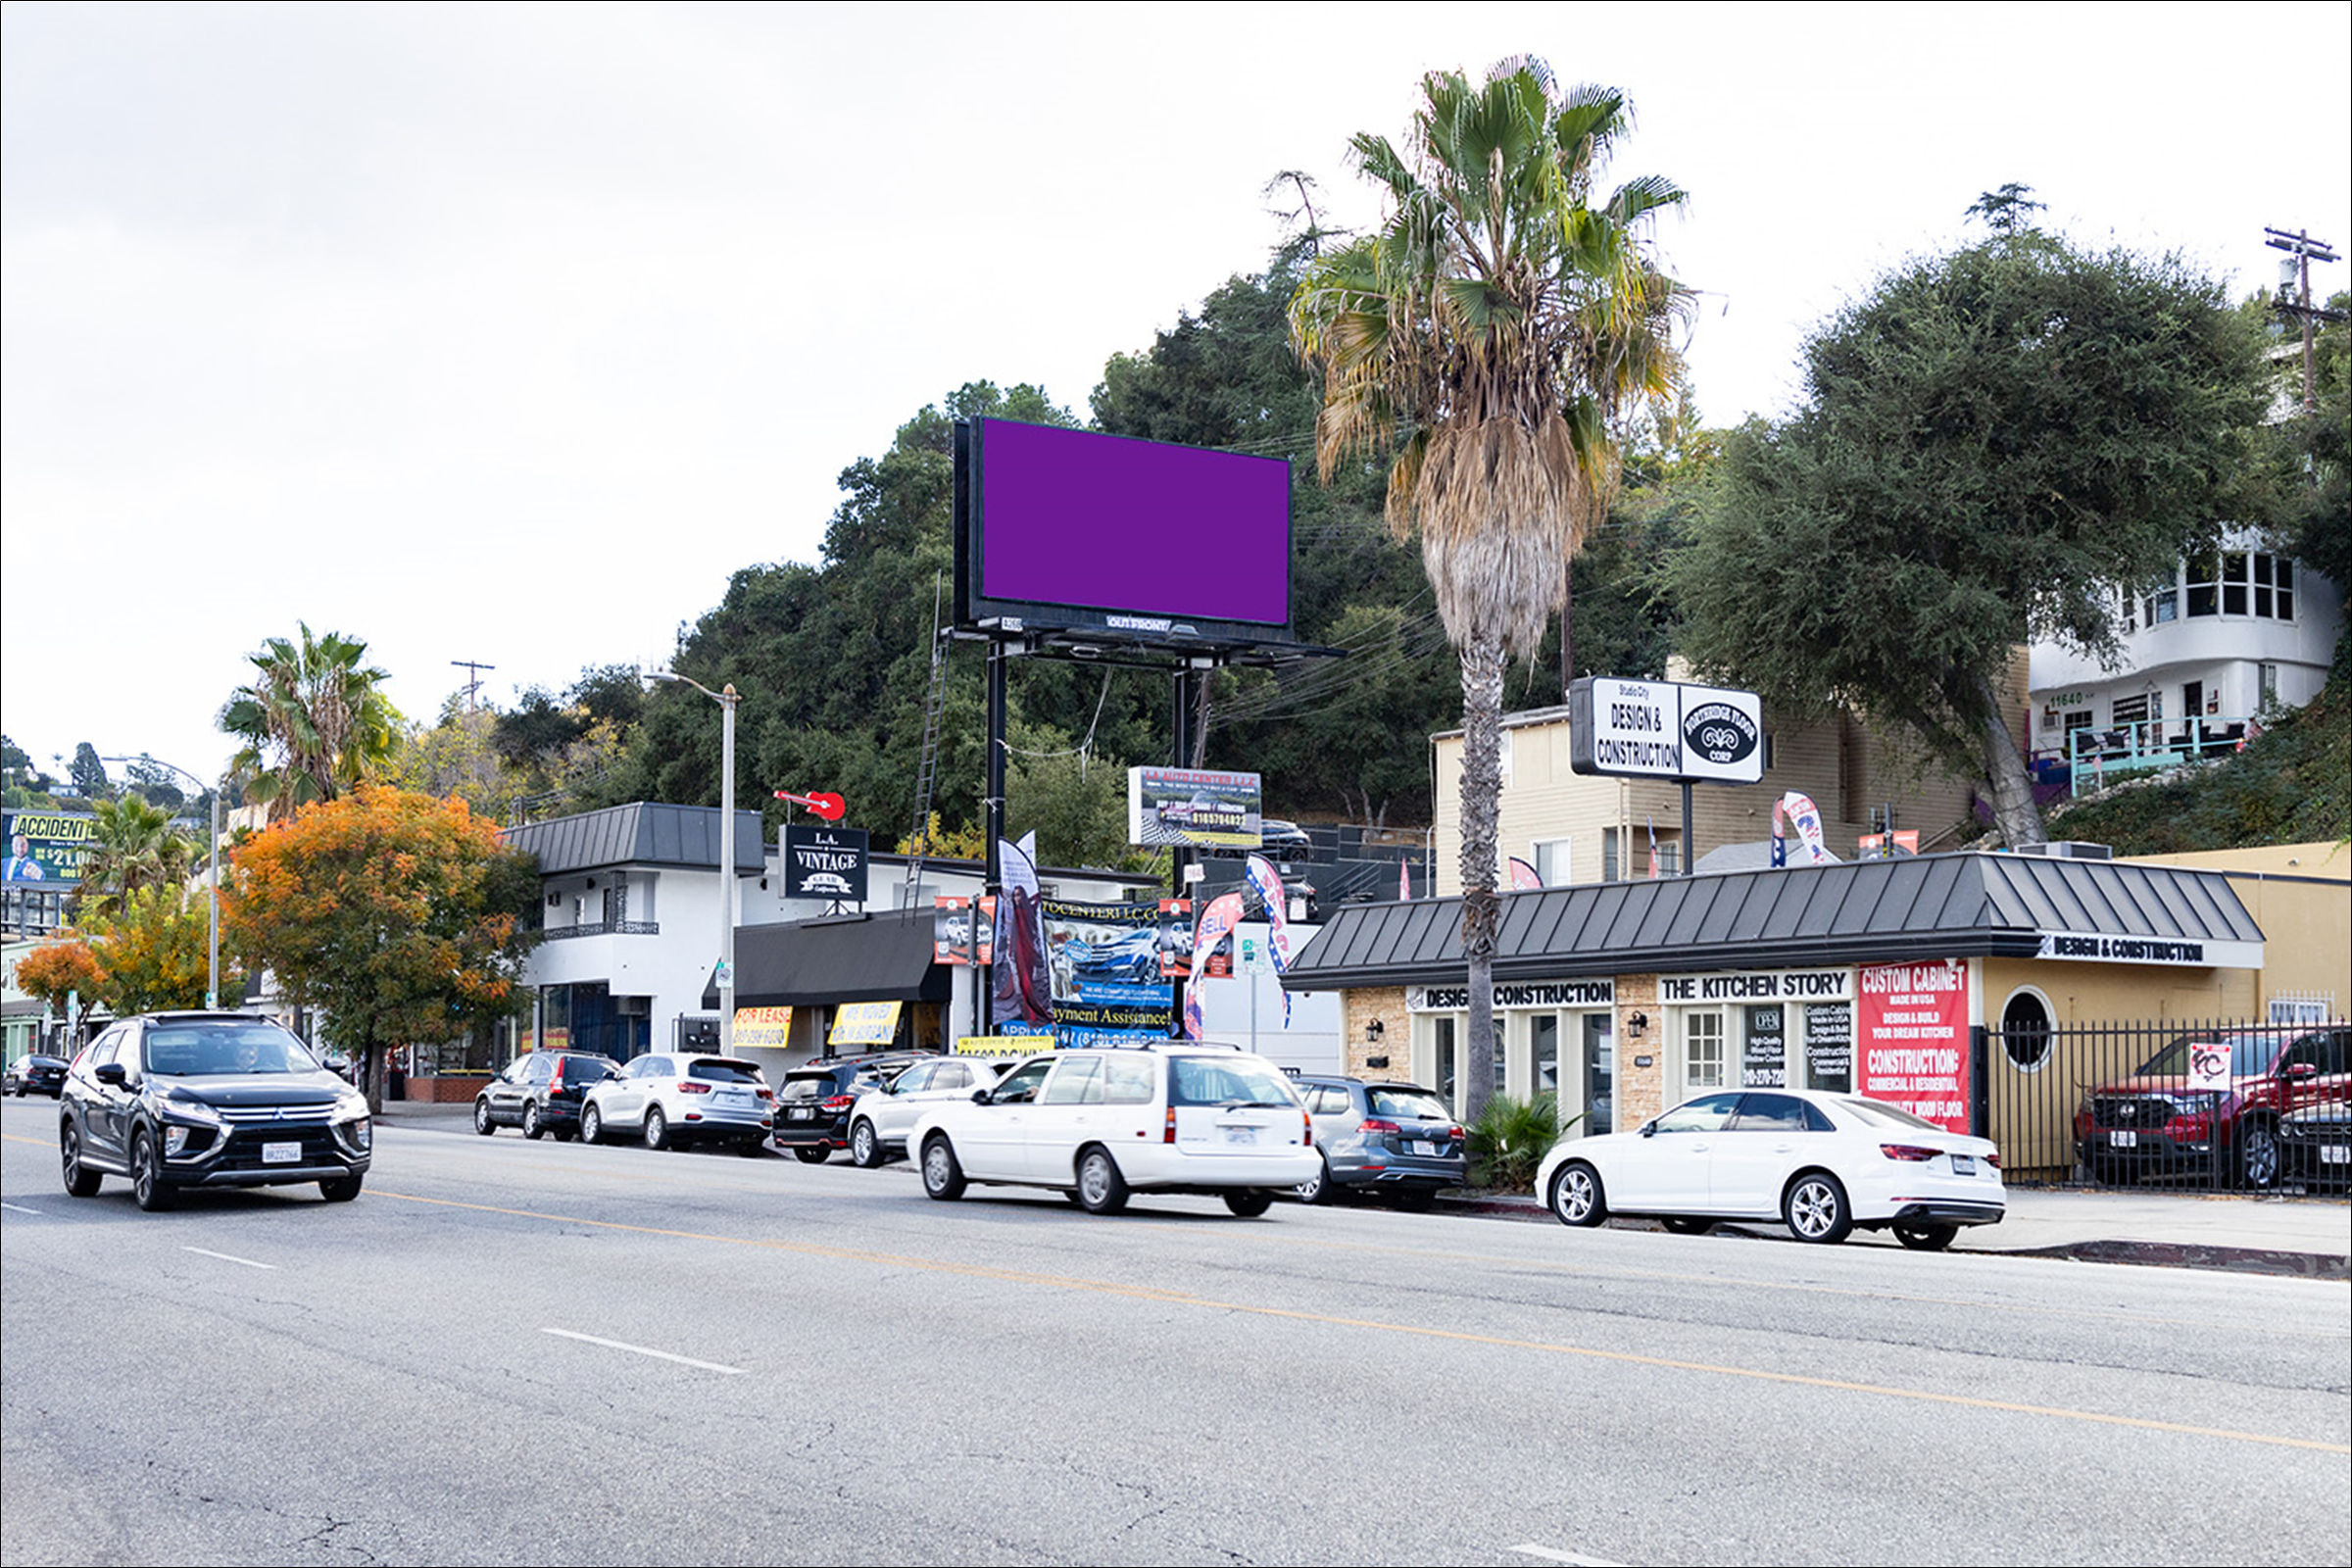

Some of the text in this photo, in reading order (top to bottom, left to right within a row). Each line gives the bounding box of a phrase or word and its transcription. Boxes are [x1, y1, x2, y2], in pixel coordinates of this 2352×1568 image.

[1619, 684, 1649, 700] Studio City
[2050, 692, 2083, 708] 11640
[1611, 703, 1662, 732] DESIGN &
[1597, 738, 1679, 768] CONSTRUCTION
[1709, 750, 1733, 762] CORP
[1146, 770, 1254, 787] LA AUTO CENTER LLC
[815, 832, 839, 845] L.A.
[796, 851, 858, 871] VINTAGE
[1199, 915, 1227, 936] SELL
[2054, 936, 2203, 961] DESIGN & CONSTRUCTION
[1662, 972, 1846, 1000] THE KITCHEN STORY
[1863, 964, 1964, 993] CUSTOM CABINET
[1427, 982, 1611, 1008] DESIG CONSTRUCTION
[1889, 994, 1936, 1005] MADE IN USA
[735, 1007, 791, 1023] FOR LEASE
[1053, 1007, 1097, 1024] ayment
[1100, 1009, 1172, 1025] Assistance!
[1805, 1005, 1851, 1015] Custom Cabine
[1884, 1012, 1909, 1025] DESIGN
[1918, 1011, 1939, 1024] BUILD
[1756, 1013, 1779, 1027] OPEN
[1872, 1026, 1953, 1039] YOUR DREAM KITCHEN
[1868, 1048, 1959, 1074] CONSTRUCTION:
[1868, 1077, 1909, 1091] COMMERCIAL
[1916, 1077, 1958, 1091] RESIDENTIAL
[1915, 1101, 1936, 1117] WOOD
[1937, 1101, 1964, 1117] FLOOR
